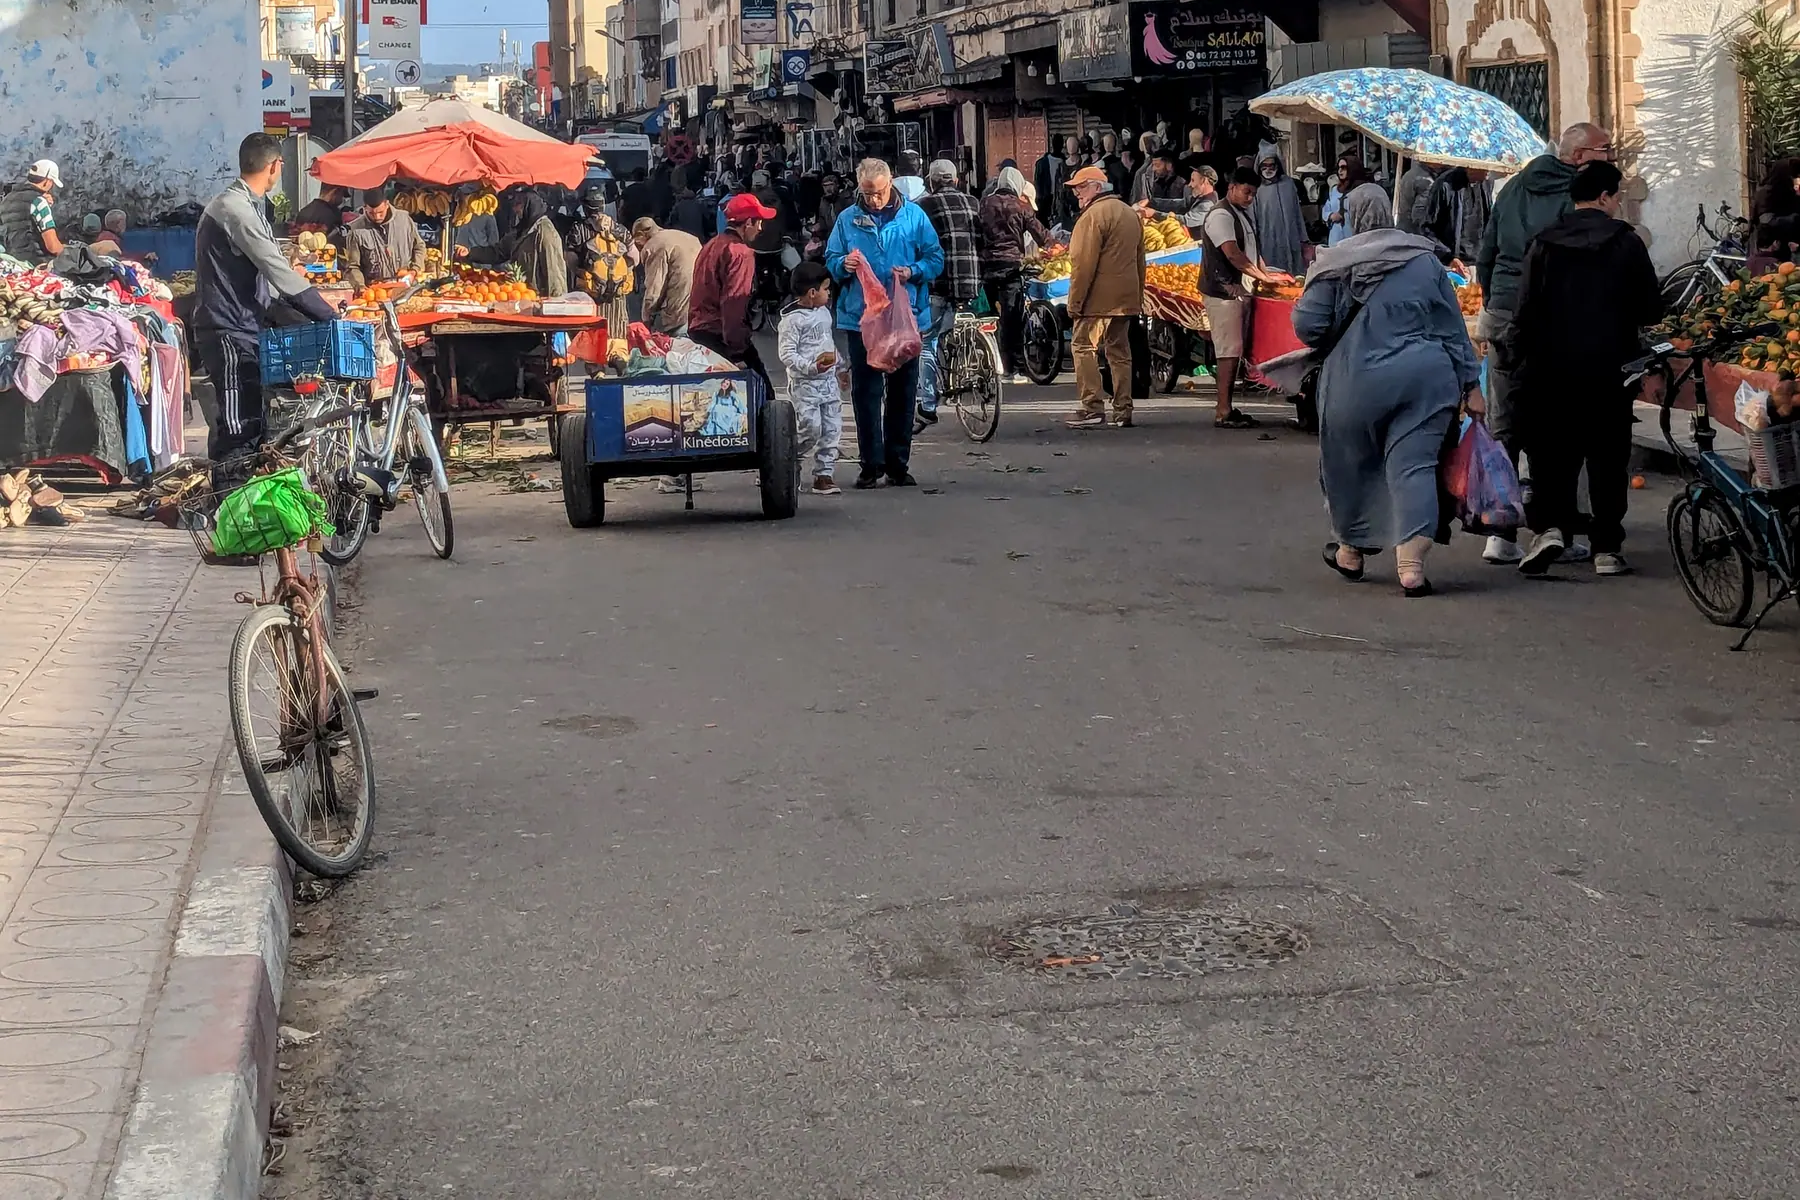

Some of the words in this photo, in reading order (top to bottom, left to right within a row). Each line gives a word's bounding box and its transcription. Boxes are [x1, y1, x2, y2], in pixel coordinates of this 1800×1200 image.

[1169, 8, 1212, 34] سلام
[1214, 8, 1265, 29] بوتيك
[1207, 31, 1264, 48] SALLAM
[262, 99, 287, 107] ANK
